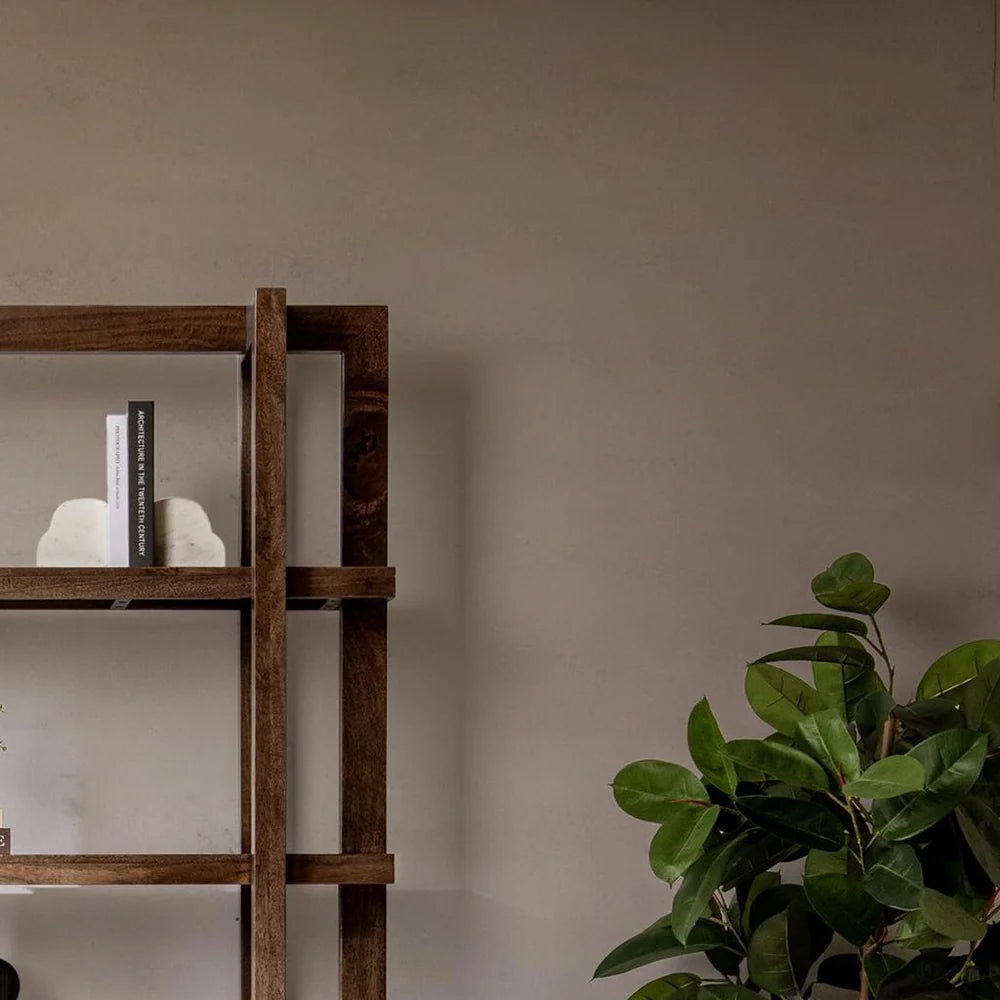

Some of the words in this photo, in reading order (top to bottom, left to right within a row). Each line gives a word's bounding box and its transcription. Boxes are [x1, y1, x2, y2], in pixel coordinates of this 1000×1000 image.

[137, 410, 145, 461] ARCHITECTURE
[137, 463, 145, 471] IN
[137, 472, 145, 485] THE
[137, 524, 145, 556] CENTURY
